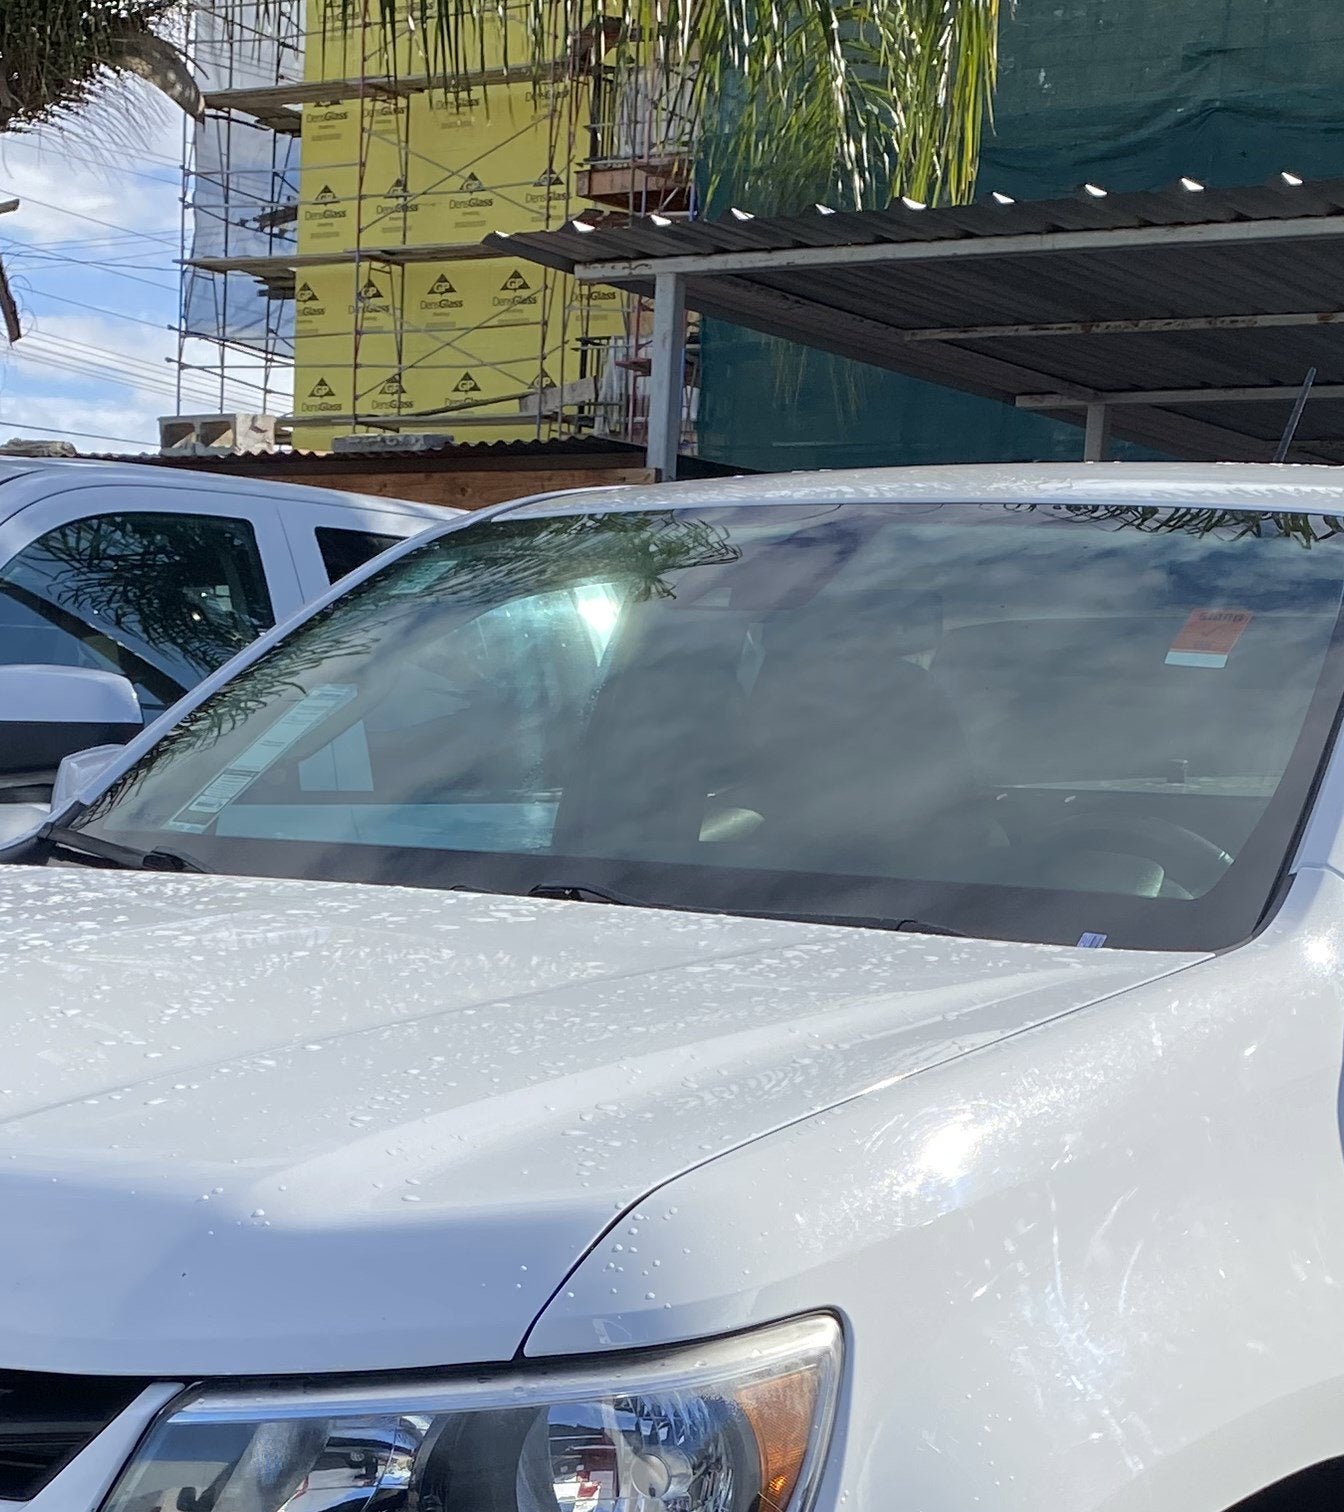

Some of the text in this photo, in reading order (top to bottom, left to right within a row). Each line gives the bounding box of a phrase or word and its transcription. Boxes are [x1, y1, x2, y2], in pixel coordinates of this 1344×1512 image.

[449, 198, 493, 209] DensGlass
[304, 209, 347, 220] DensGlass
[420, 299, 463, 310] DensGlass
